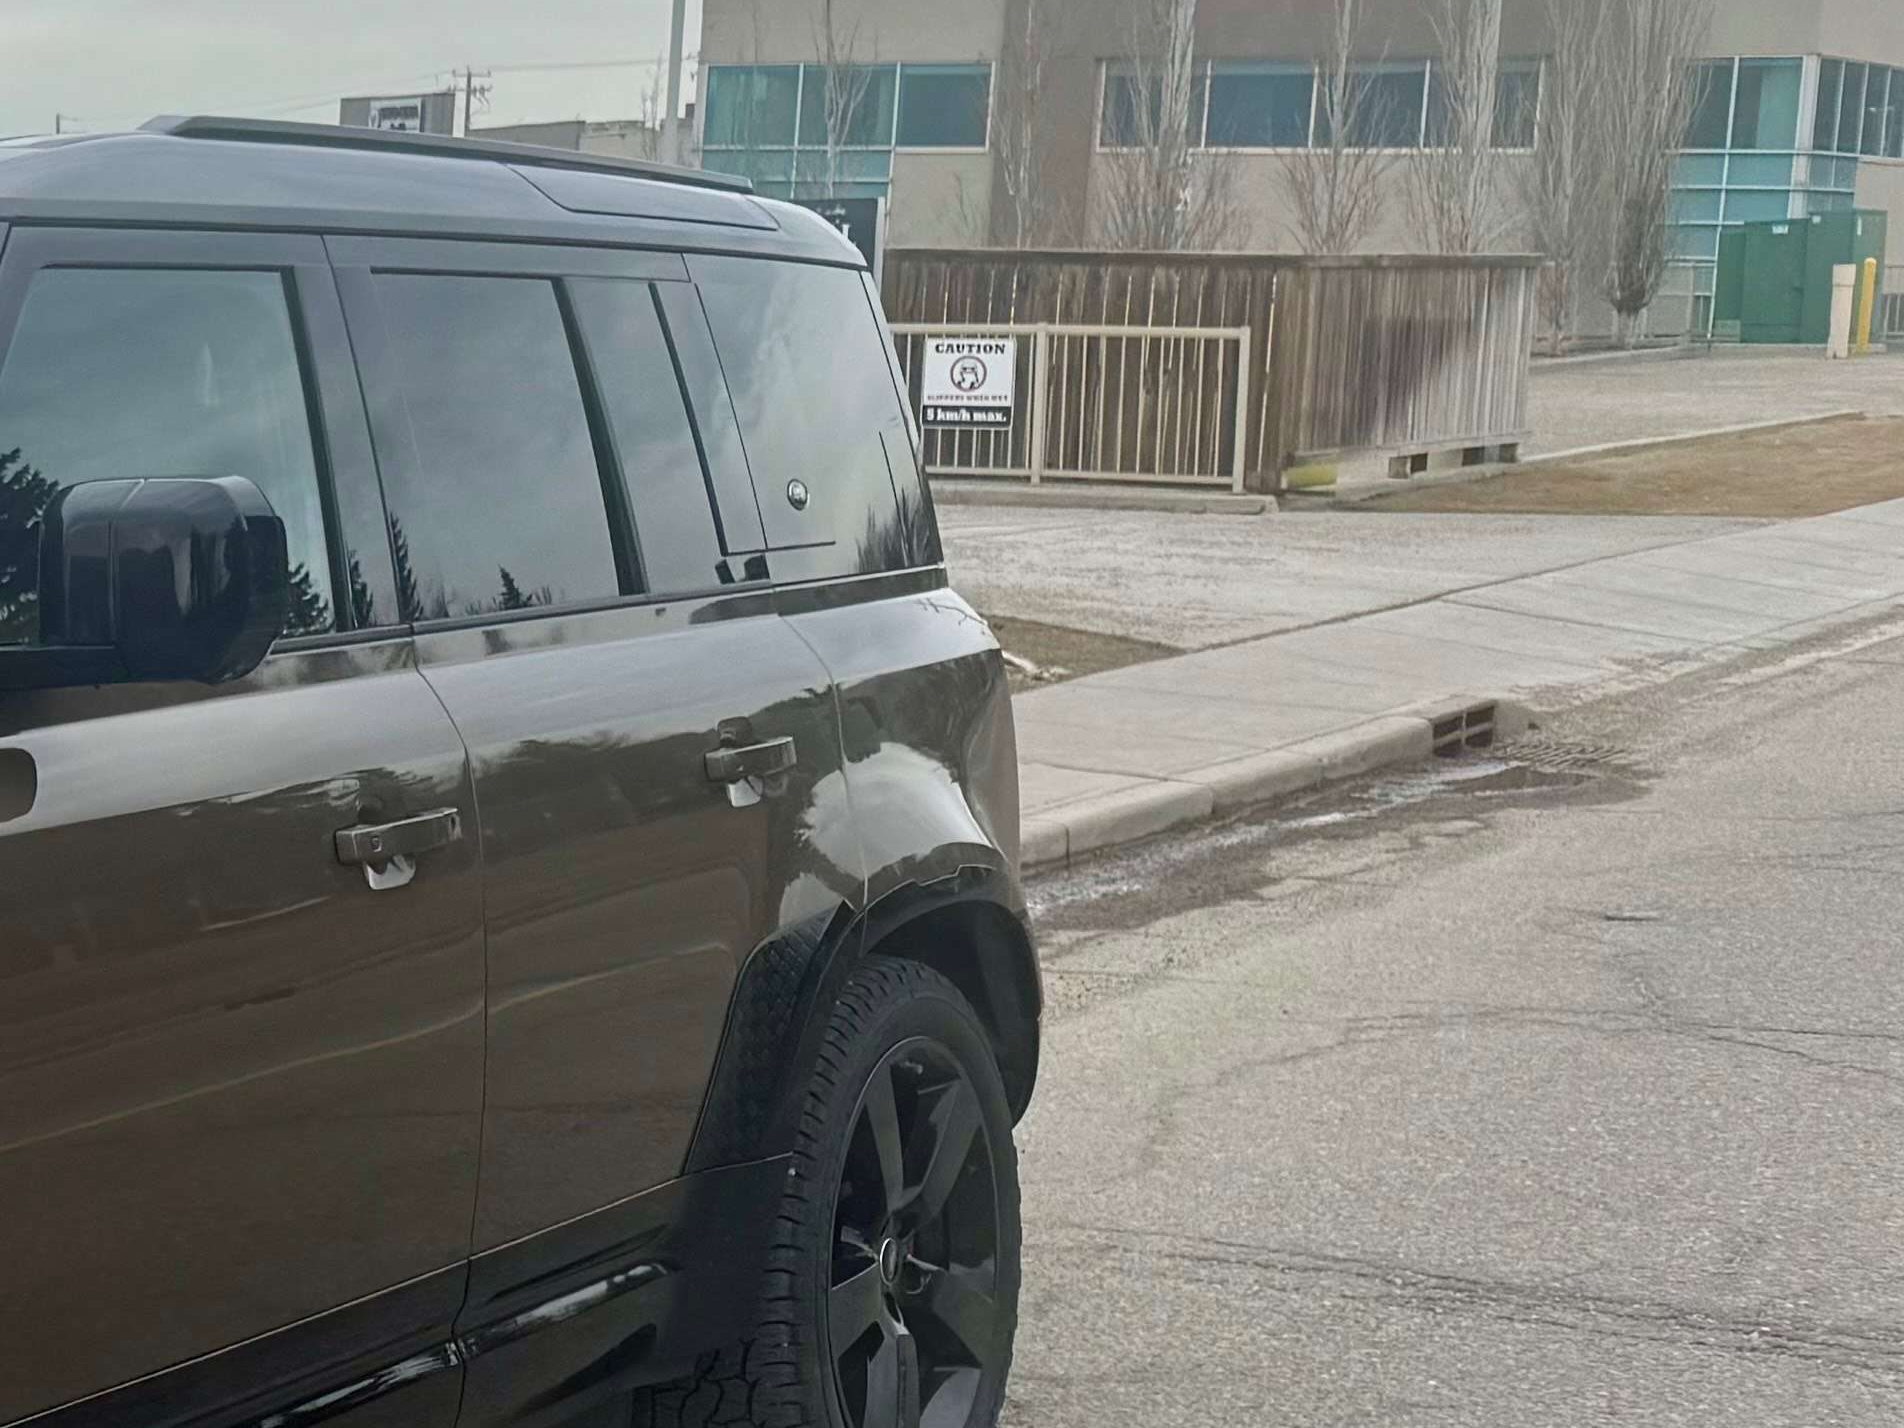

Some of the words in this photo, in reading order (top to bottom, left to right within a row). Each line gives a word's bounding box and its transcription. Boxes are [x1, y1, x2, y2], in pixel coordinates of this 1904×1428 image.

[935, 343, 1006, 354] CAUTION
[927, 407, 934, 421] 5
[936, 407, 971, 421] km/h
[973, 411, 1007, 422] max.
